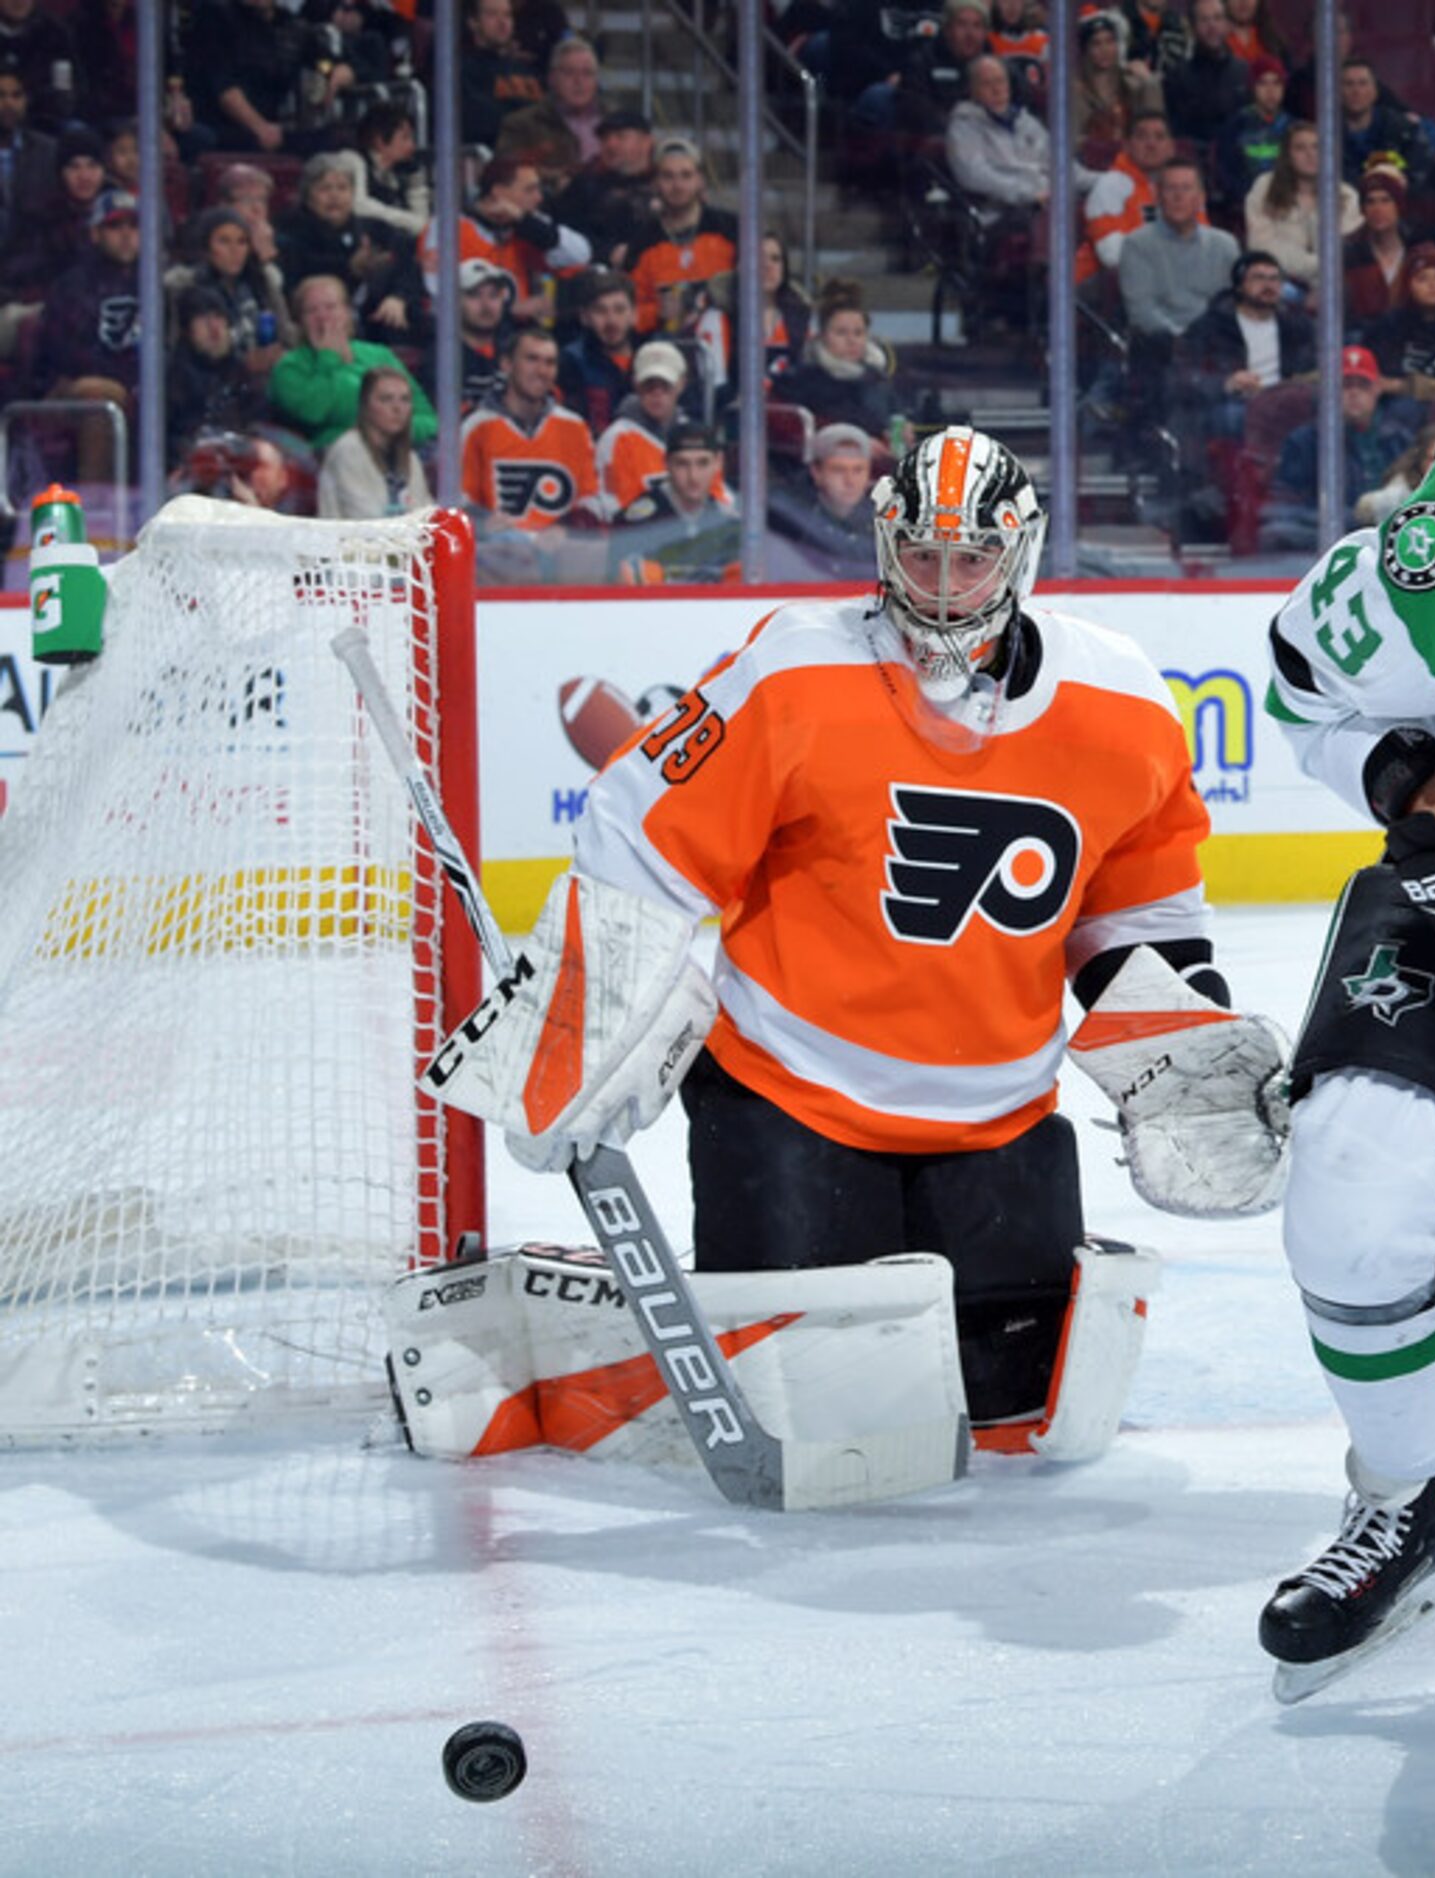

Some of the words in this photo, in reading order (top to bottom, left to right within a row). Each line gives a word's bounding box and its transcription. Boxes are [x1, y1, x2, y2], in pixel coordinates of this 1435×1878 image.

[1311, 546, 1384, 677] 43
[640, 688, 726, 785] 79
[426, 953, 536, 1087] CCM
[1121, 1053, 1173, 1104] CCM
[523, 1270, 628, 1309] CCM
[588, 1187, 744, 1450] BAUER
